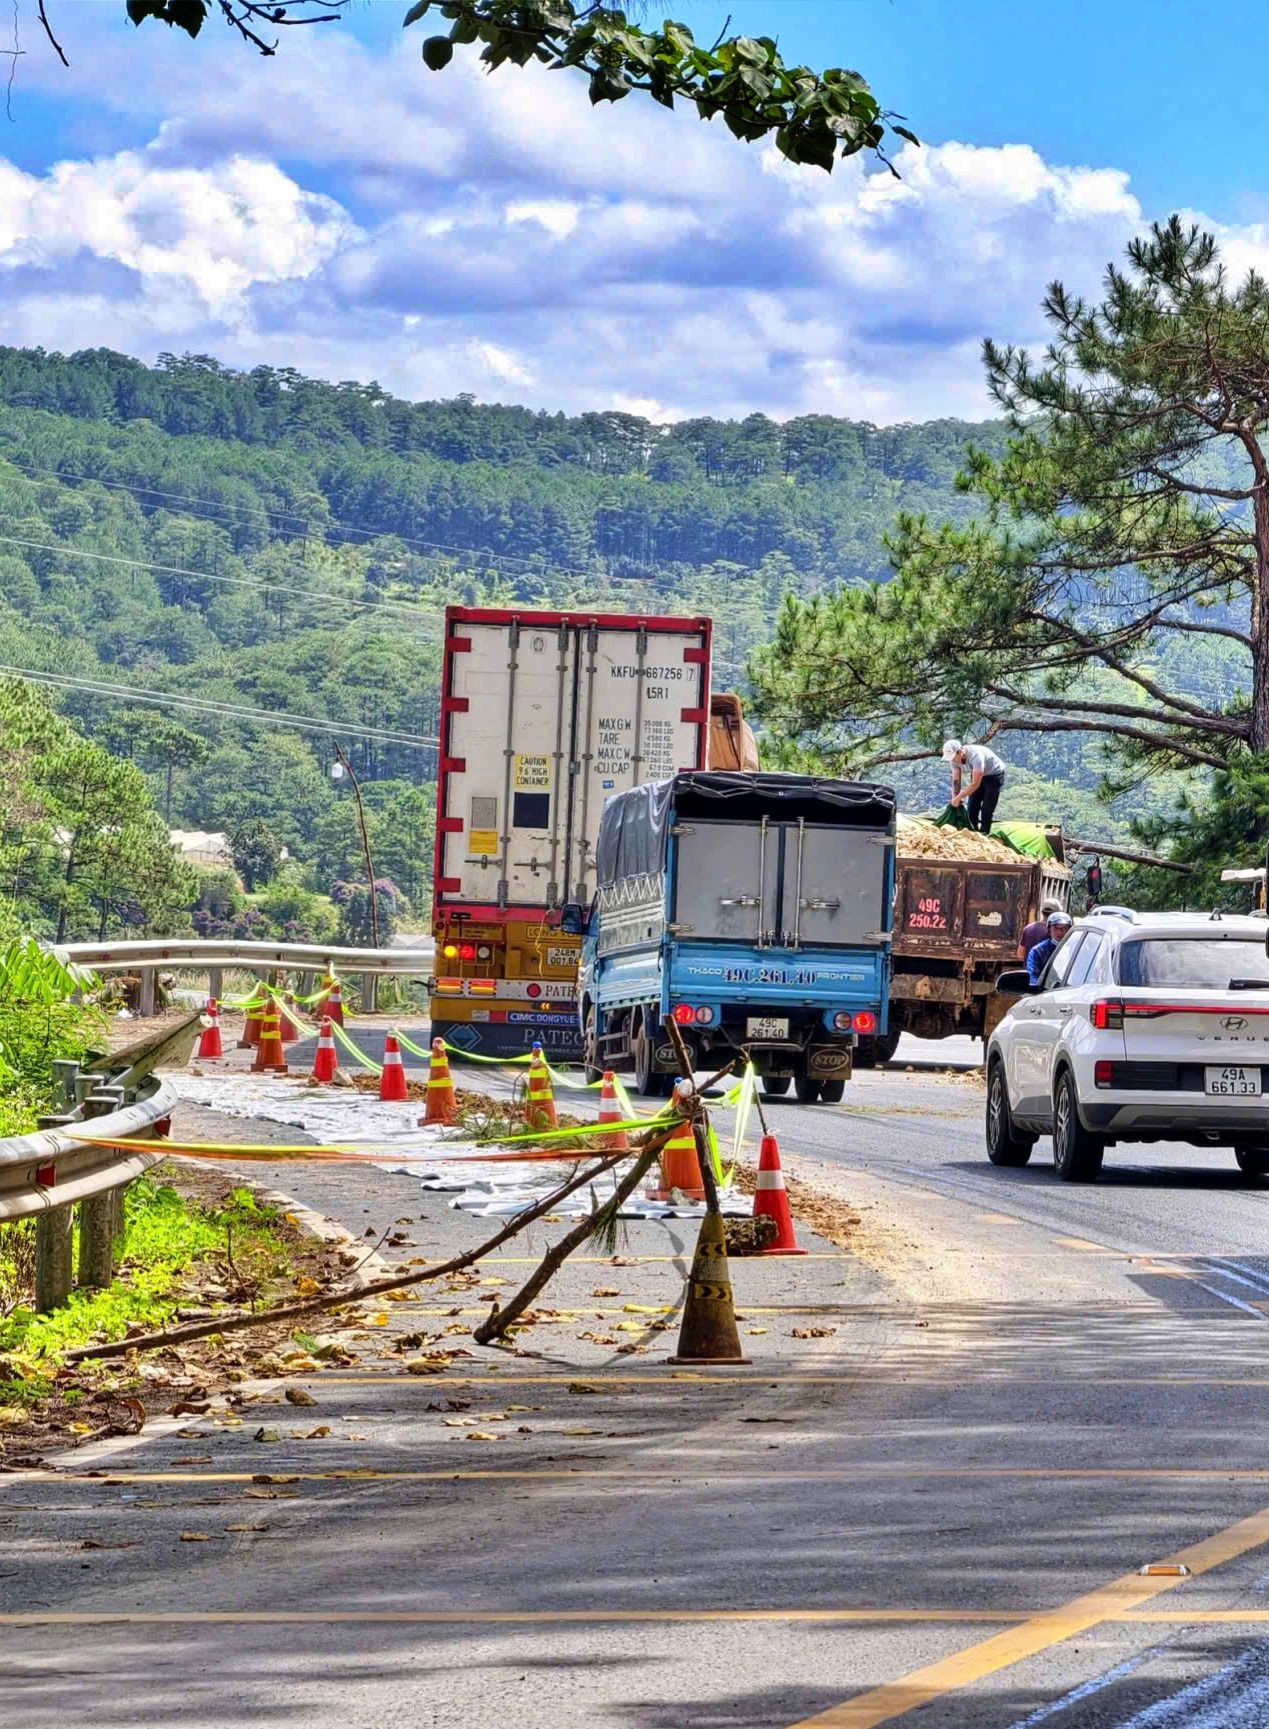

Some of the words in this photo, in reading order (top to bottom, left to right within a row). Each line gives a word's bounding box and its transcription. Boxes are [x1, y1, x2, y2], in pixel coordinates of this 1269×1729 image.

[646, 667, 682, 680] 667256
[599, 732, 620, 746] TARE
[520, 756, 548, 766] CAUTION
[516, 776, 550, 786] CONTAINER
[919, 898, 940, 913] 49C
[909, 913, 946, 929] 250.22
[687, 967, 722, 976] THACO
[816, 972, 866, 981] FRONTIER
[510, 1013, 536, 1022] CIMC
[759, 1018, 778, 1028] 49C
[815, 1054, 847, 1064] STOP
[1221, 1068, 1246, 1081] 49A
[1211, 1081, 1256, 1093] 661.33
